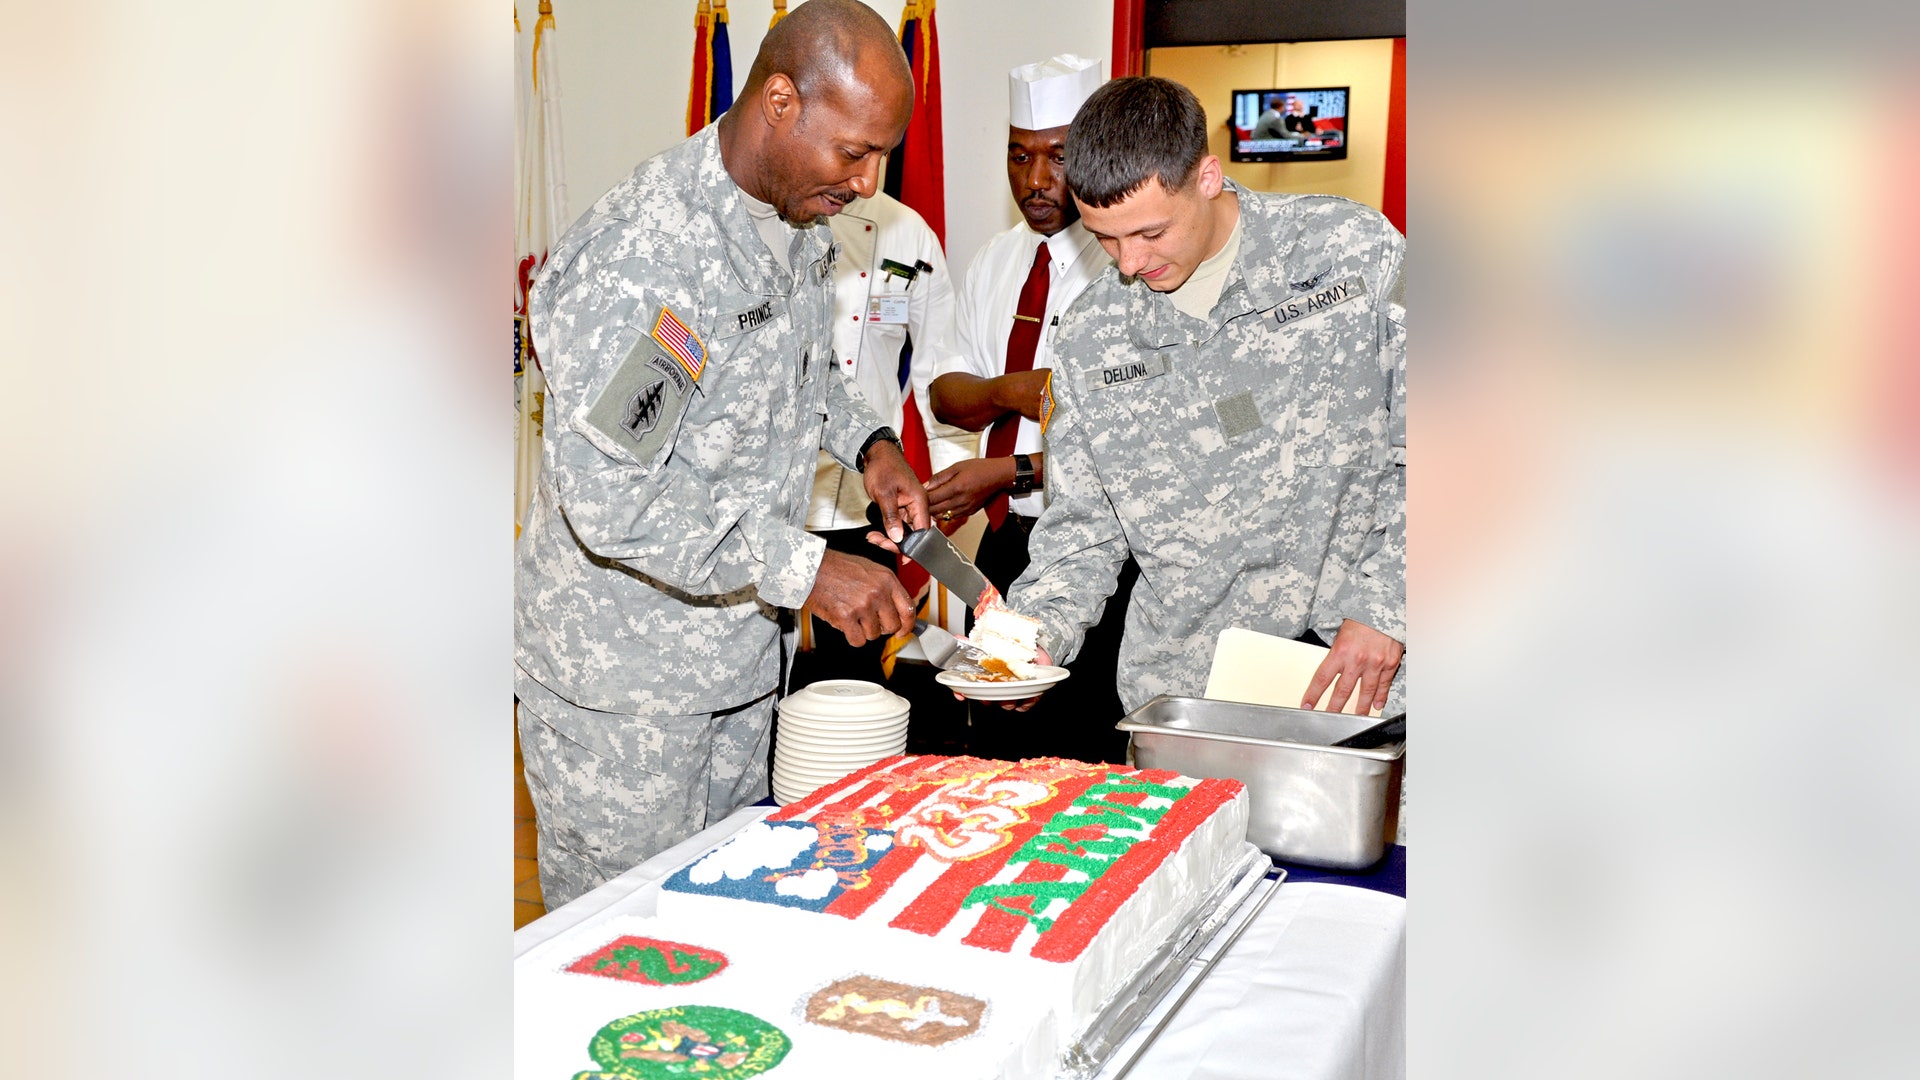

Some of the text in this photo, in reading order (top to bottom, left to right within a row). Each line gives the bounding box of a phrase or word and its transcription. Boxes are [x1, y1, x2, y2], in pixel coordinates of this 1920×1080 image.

[737, 301, 773, 330] PRINCE
[1274, 281, 1350, 324] U.S. ARMY
[652, 357, 685, 391] AIRBORNE
[1103, 363, 1148, 386] DELUNA
[892, 779, 1056, 863] 235
[962, 773, 1190, 934] ARMY
